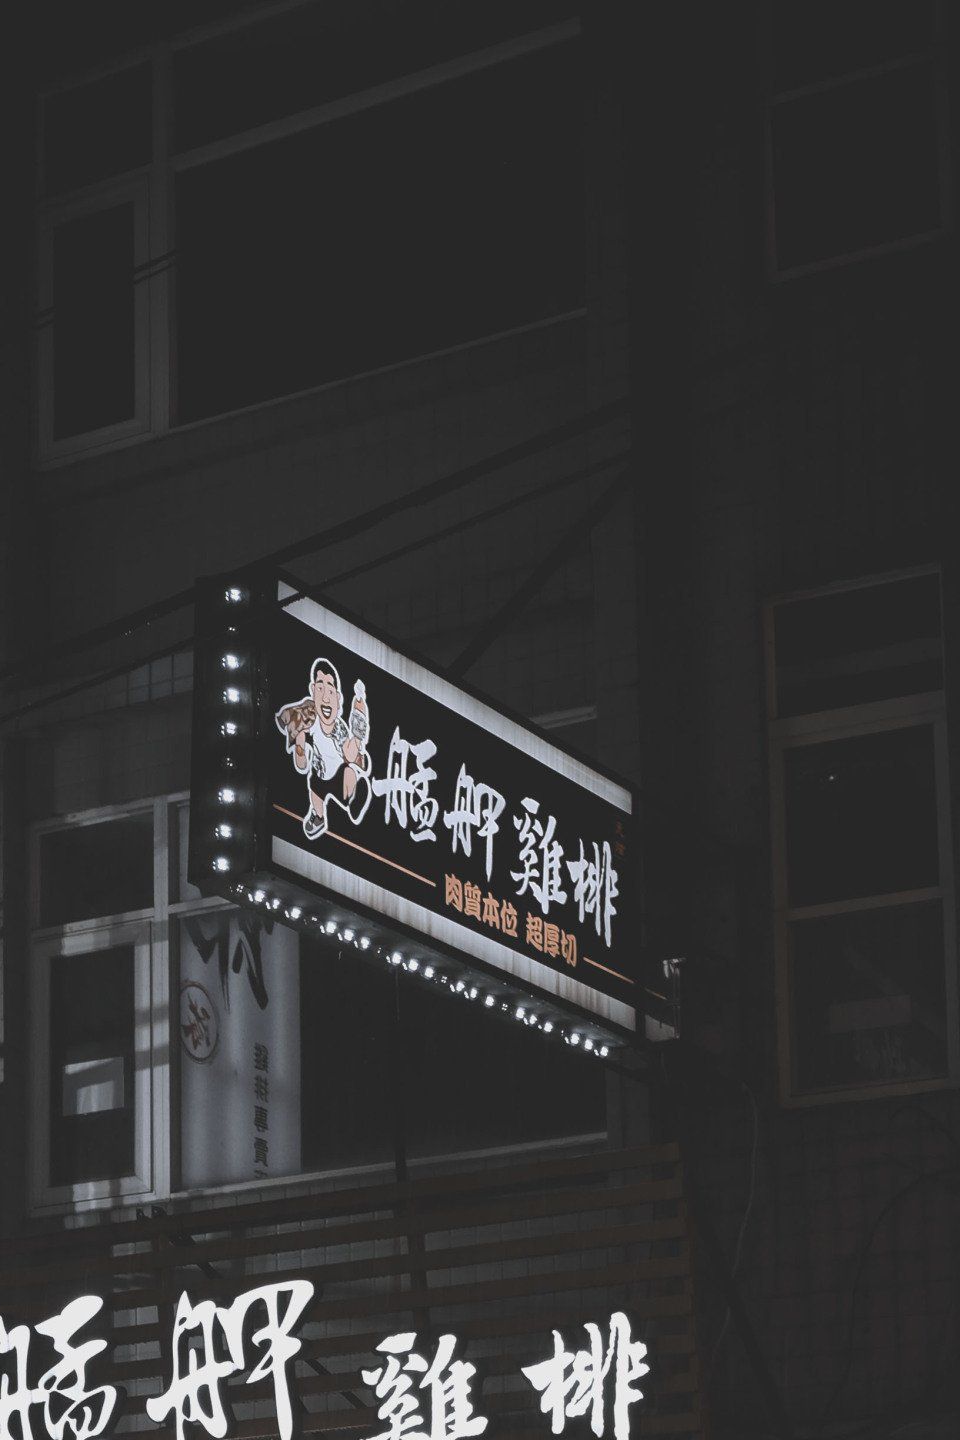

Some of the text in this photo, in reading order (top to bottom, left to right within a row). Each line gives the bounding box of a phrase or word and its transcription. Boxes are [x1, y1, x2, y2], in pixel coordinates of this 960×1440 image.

[445, 873, 577, 967] 肉質本位 超厚切
